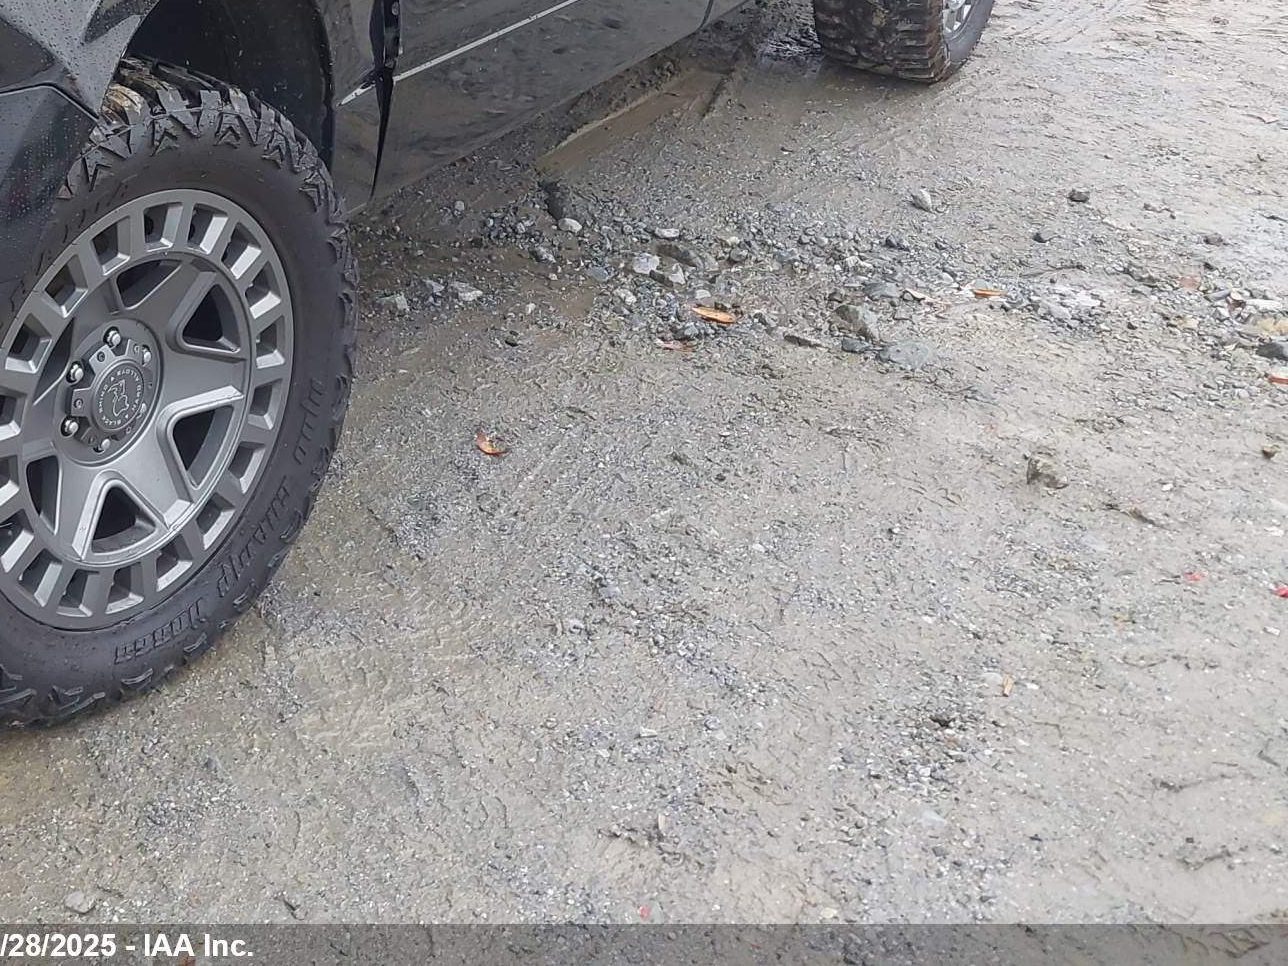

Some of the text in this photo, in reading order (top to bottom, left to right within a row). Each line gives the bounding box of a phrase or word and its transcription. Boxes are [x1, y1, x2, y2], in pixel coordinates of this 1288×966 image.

[98, 383, 122, 426] BLACK RHINO
[116, 368, 142, 412] HARD ALLOYS
